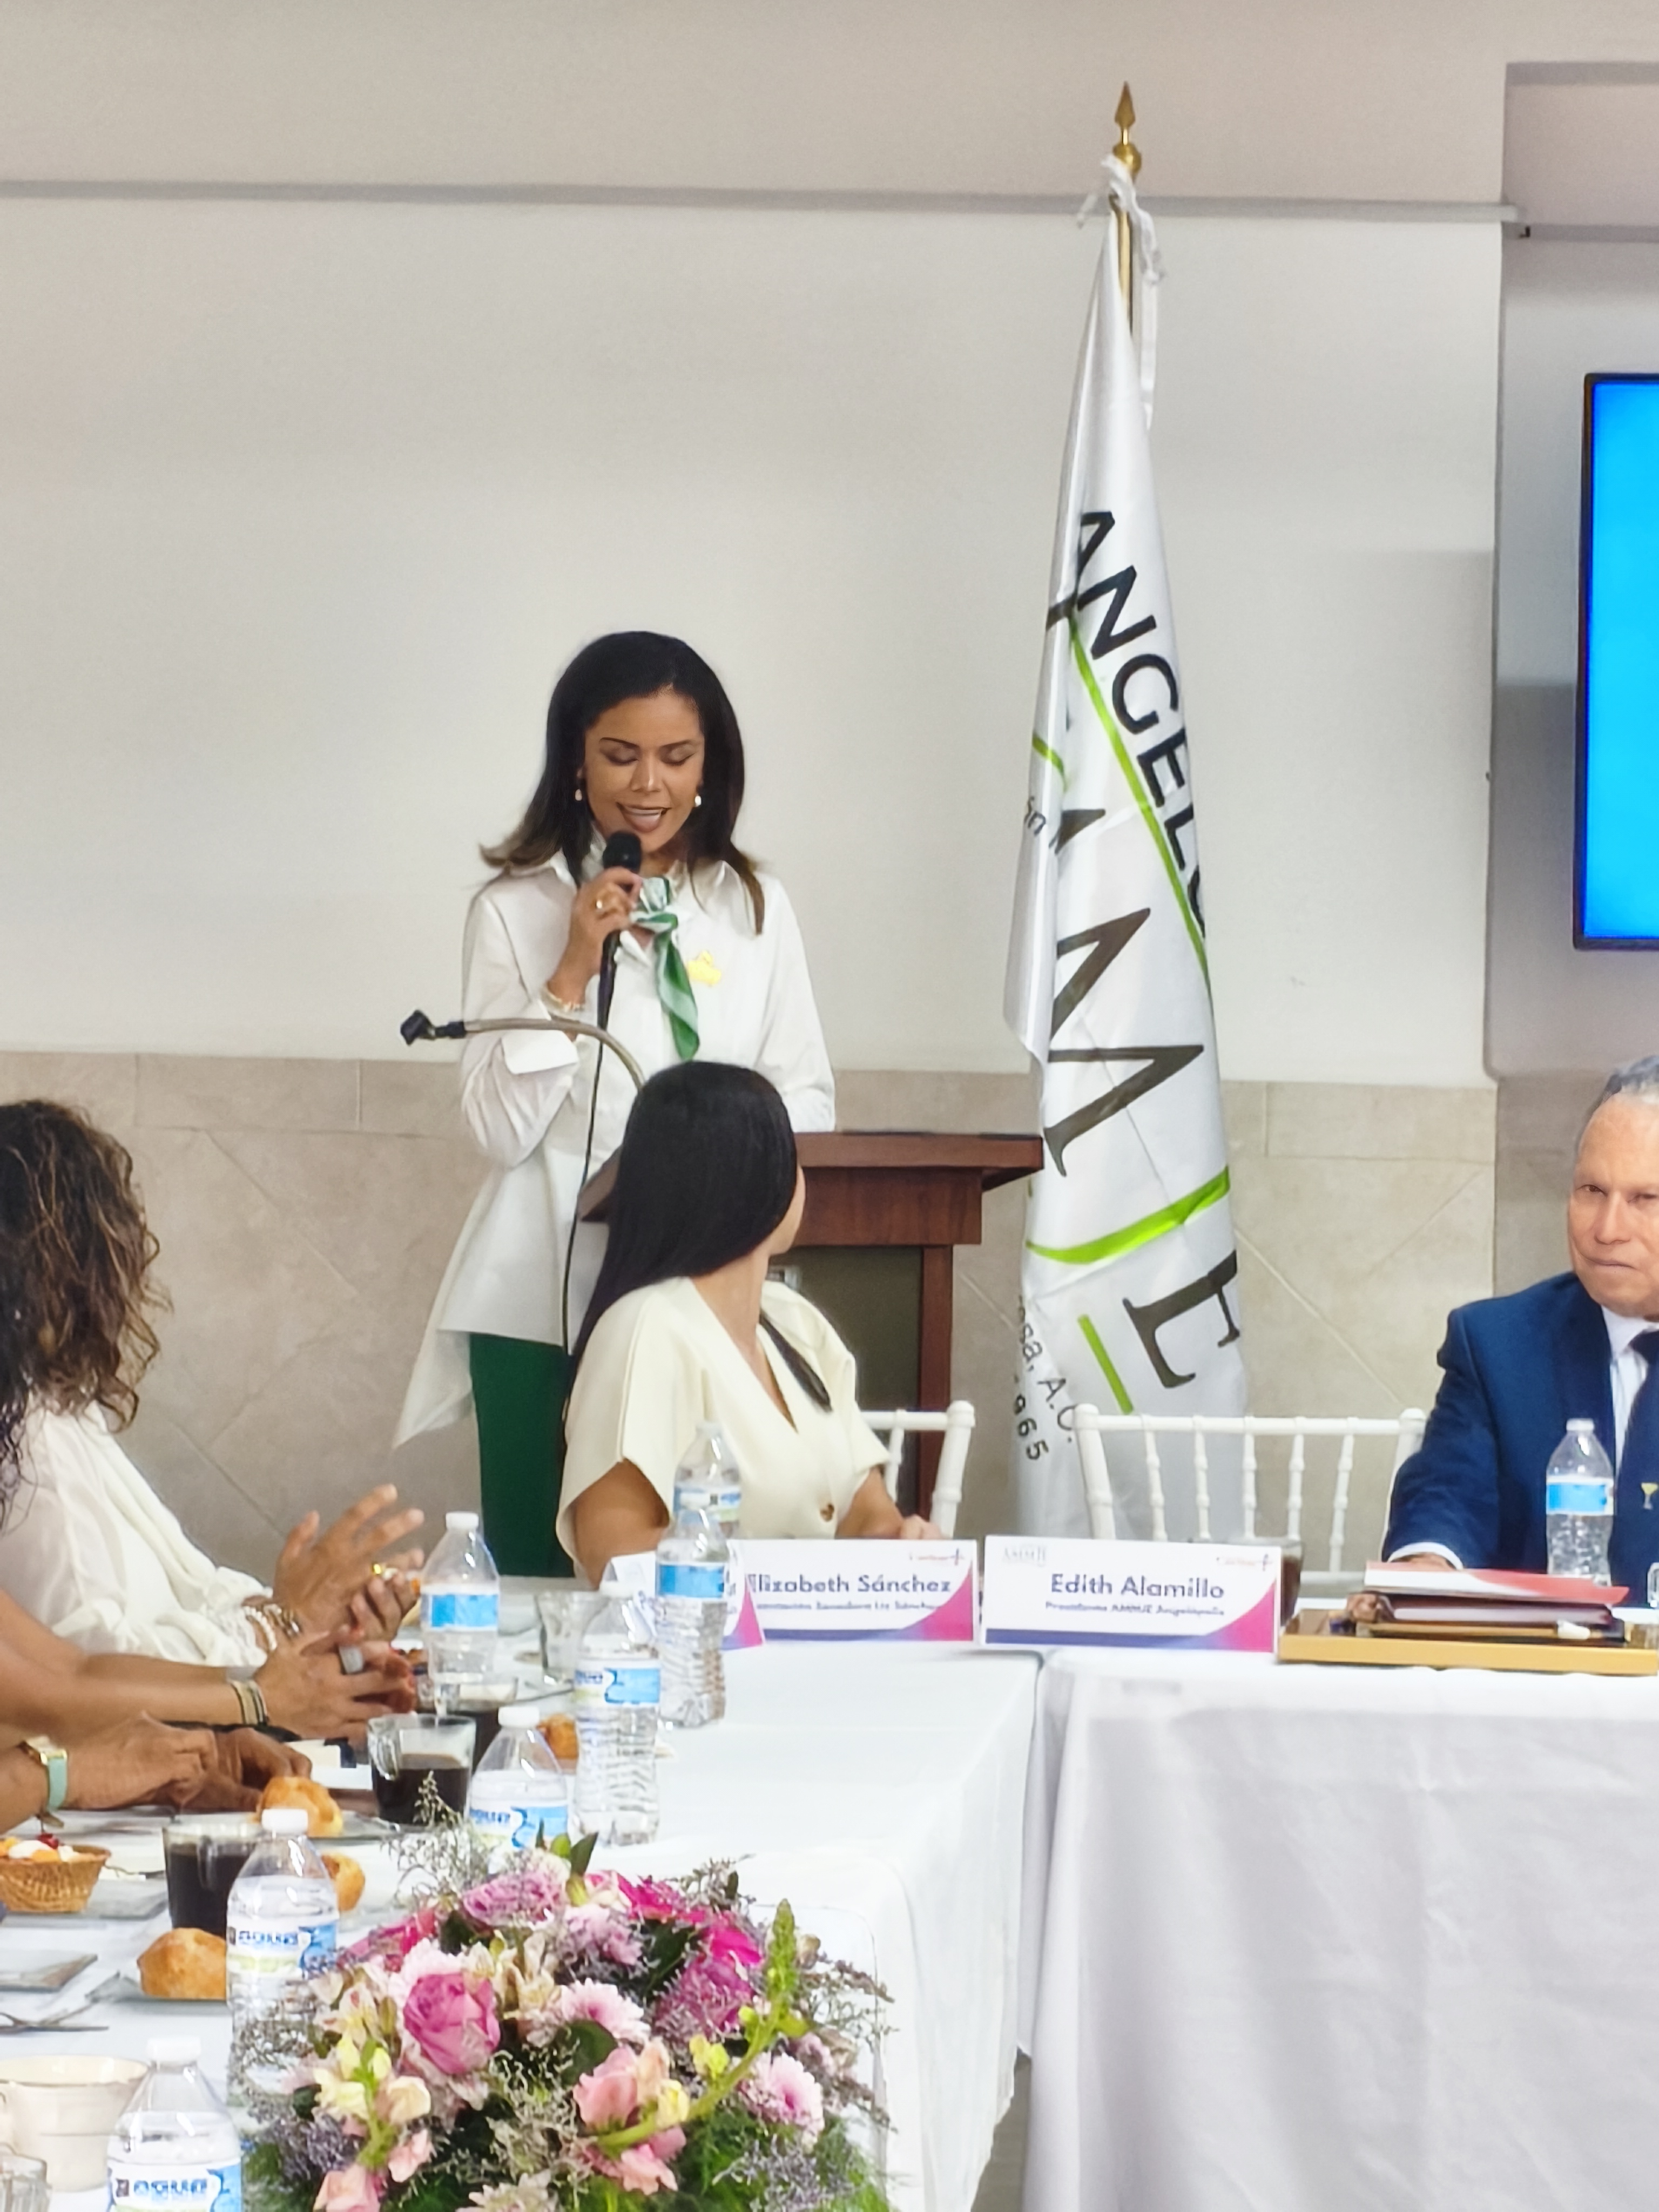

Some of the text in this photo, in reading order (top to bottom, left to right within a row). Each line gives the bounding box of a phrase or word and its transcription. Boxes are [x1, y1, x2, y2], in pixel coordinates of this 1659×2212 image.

[857, 1573, 951, 1593] Sánchez
[1051, 1573, 1225, 1599] Edith Alamillo
